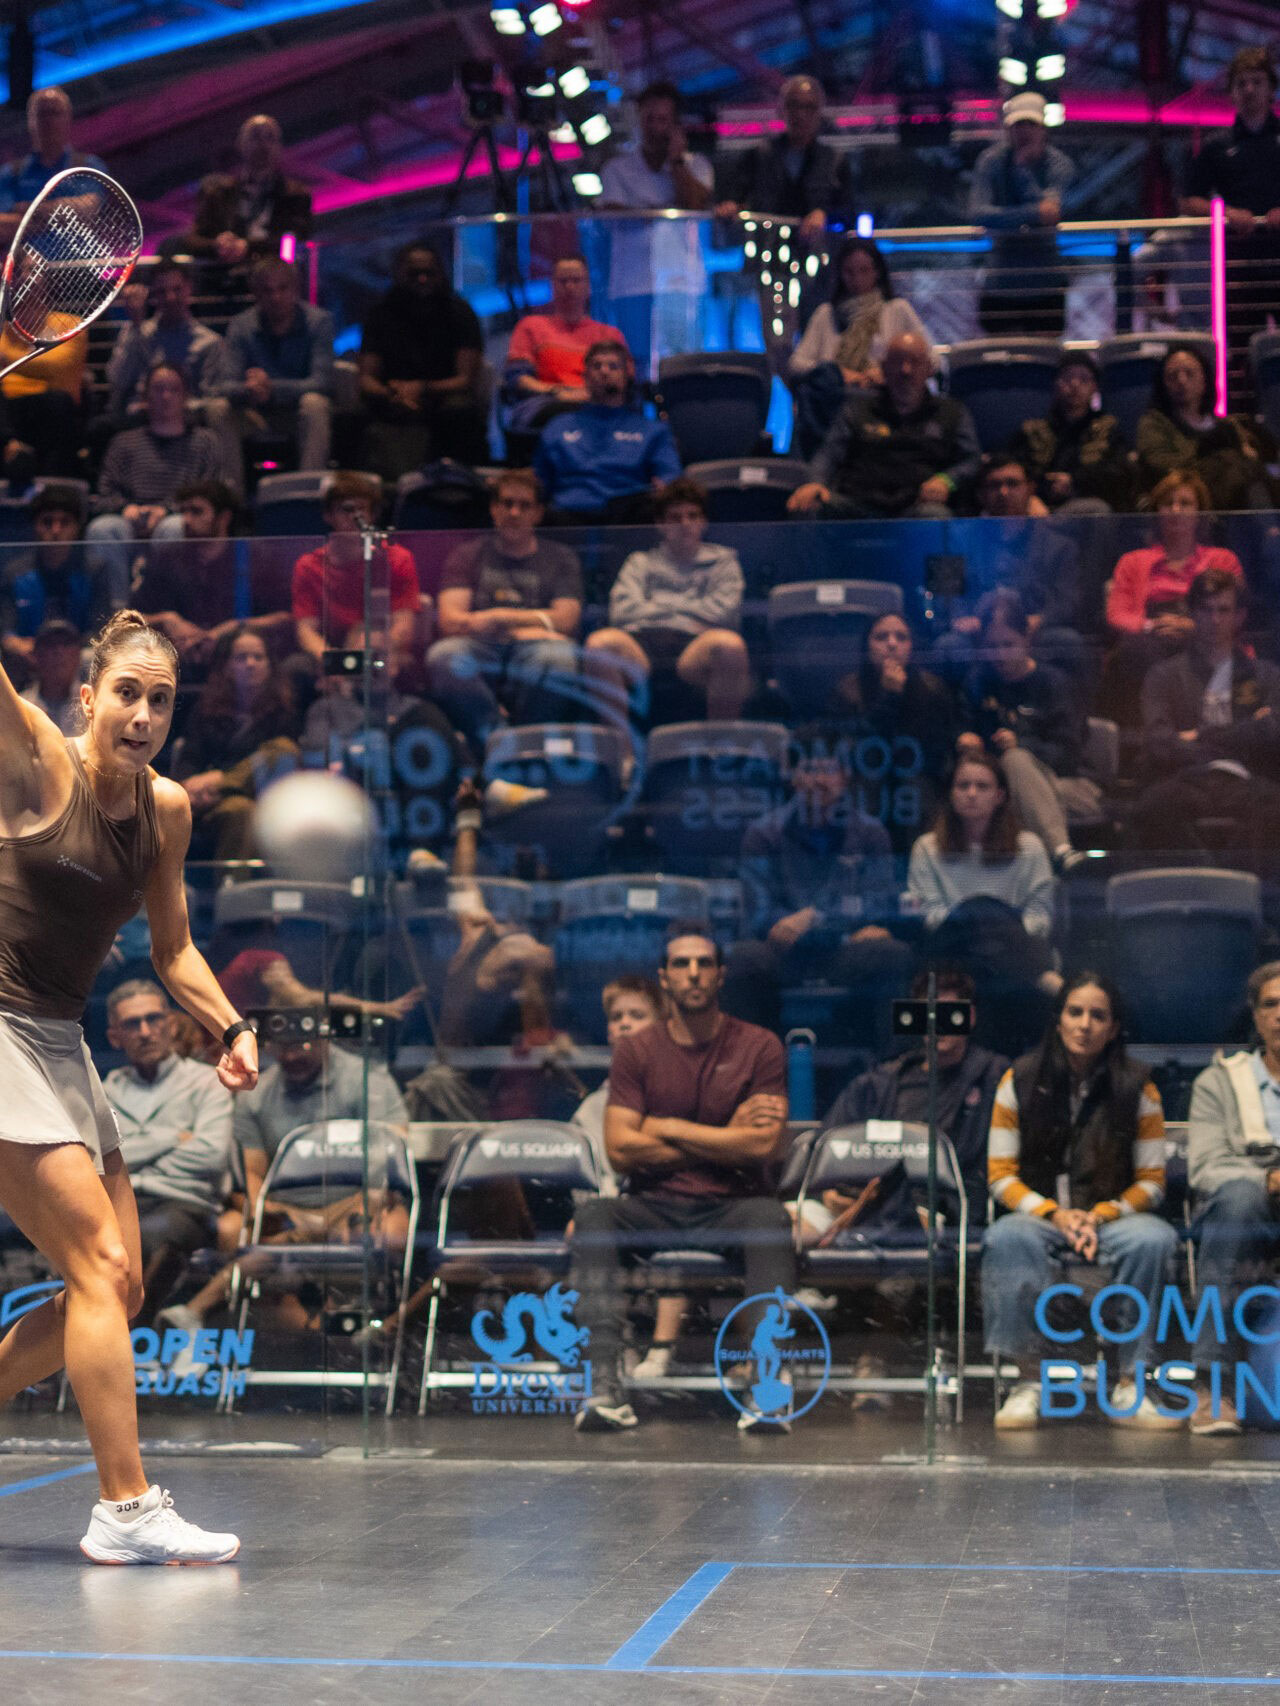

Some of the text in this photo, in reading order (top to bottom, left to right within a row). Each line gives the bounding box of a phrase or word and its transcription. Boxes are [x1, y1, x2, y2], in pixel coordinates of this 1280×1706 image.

[500, 1143, 581, 1158] US SQUASH
[851, 1142, 871, 1158] US
[1035, 1283, 1280, 1344] COMC
[130, 1327, 255, 1365] OPEN
[470, 1360, 592, 1399] Drexel
[1040, 1359, 1280, 1420] BUSIN
[116, 1501, 140, 1513] 305
